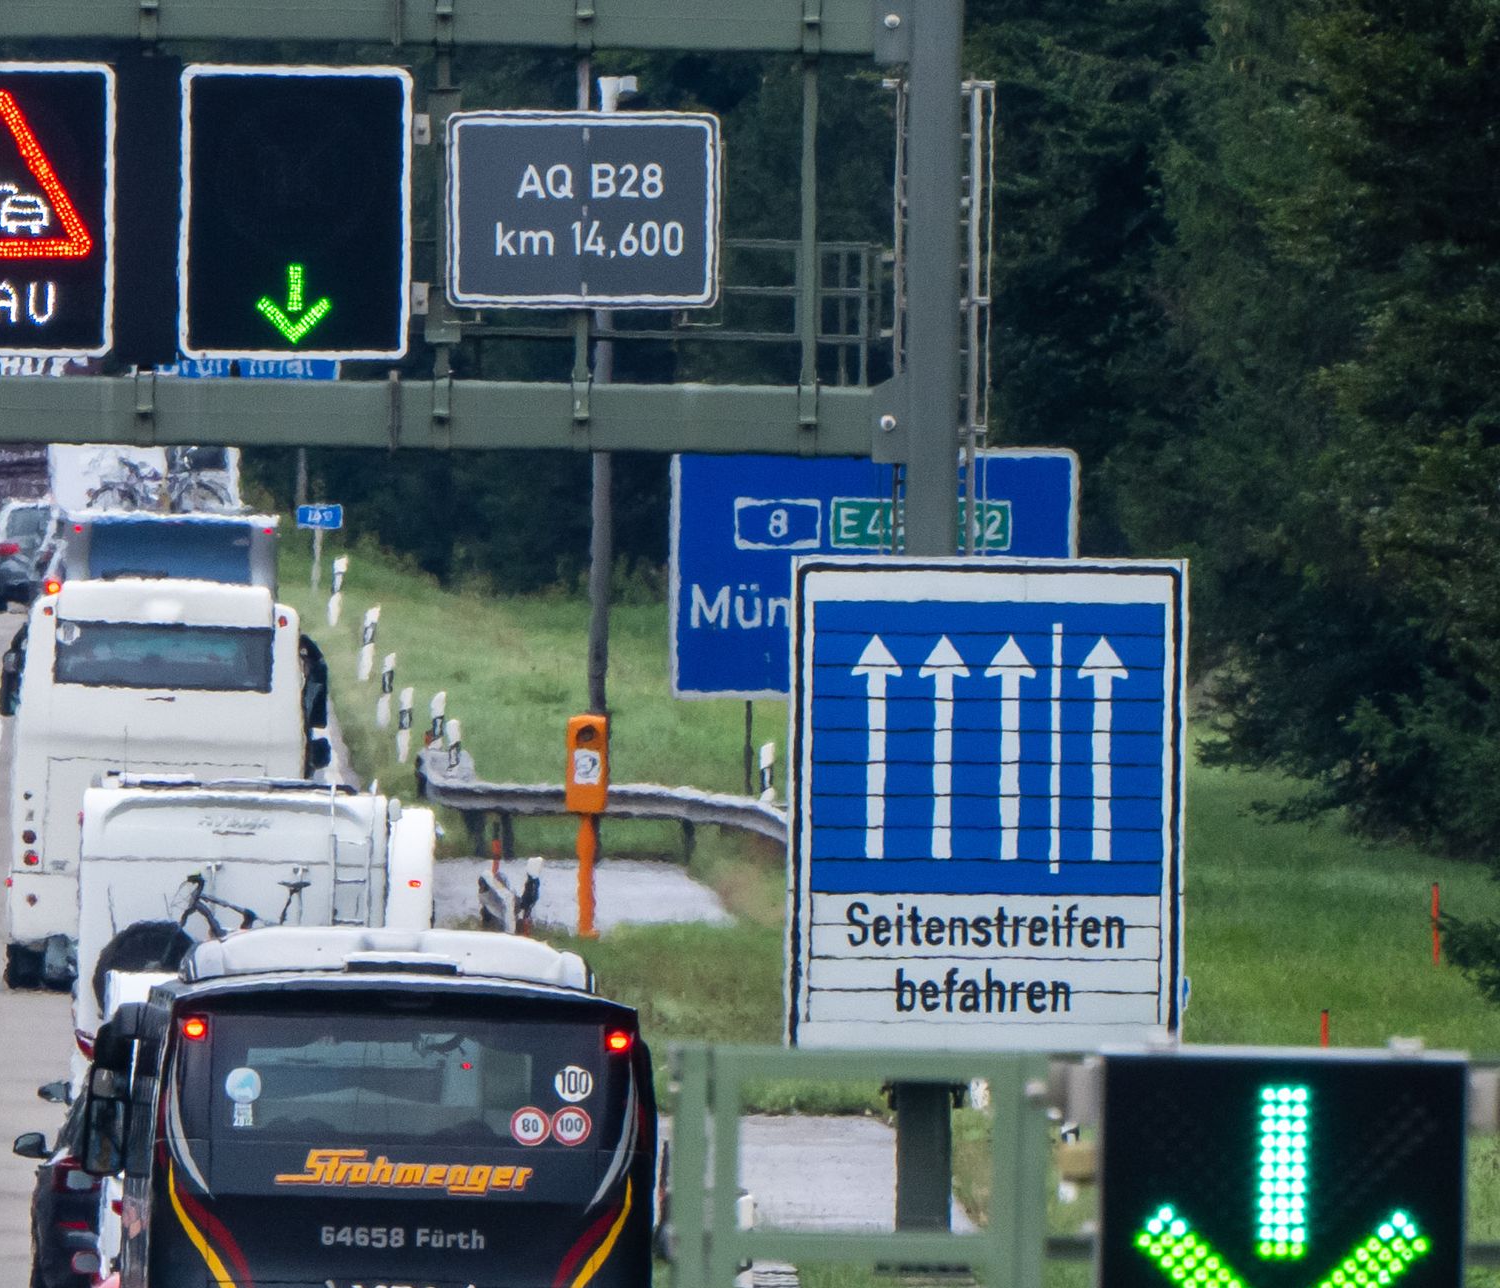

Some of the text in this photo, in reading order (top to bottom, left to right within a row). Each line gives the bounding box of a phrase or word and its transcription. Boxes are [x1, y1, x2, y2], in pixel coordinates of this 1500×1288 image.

[516, 163, 665, 201] AQ B28
[494, 220, 685, 260] km 14,600
[769, 508, 786, 540] 8
[840, 509, 859, 541] E
[845, 900, 1127, 949] Seitenstreifen
[896, 968, 1073, 1014] befahren
[560, 1071, 589, 1096] 100
[521, 1117, 584, 1134] 80 100
[320, 1227, 486, 1251] 64658 Fürth
